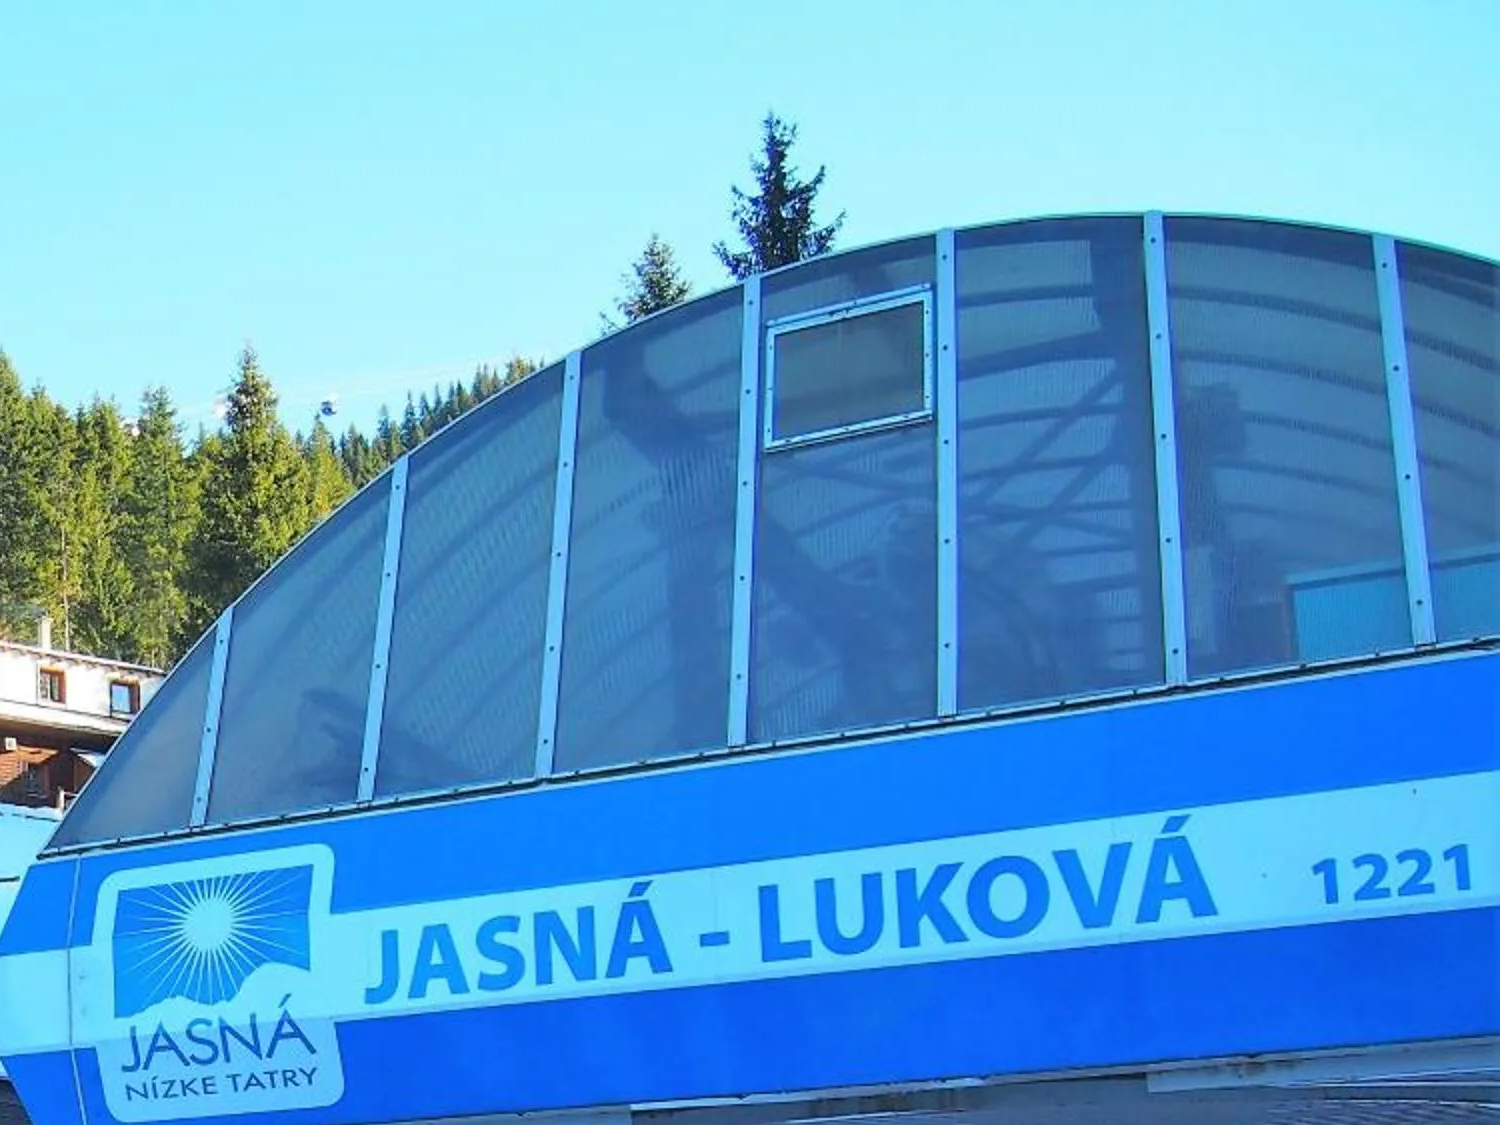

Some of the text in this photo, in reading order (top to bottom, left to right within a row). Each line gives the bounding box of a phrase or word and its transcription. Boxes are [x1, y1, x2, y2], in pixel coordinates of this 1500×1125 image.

[363, 879, 674, 1005] JASNÁ
[757, 814, 1219, 963] LUKOVÁ
[1311, 843, 1473, 905] 1221
[121, 992, 317, 1073] JASNÁ
[125, 1066, 318, 1102] NÍZKE TATRY
